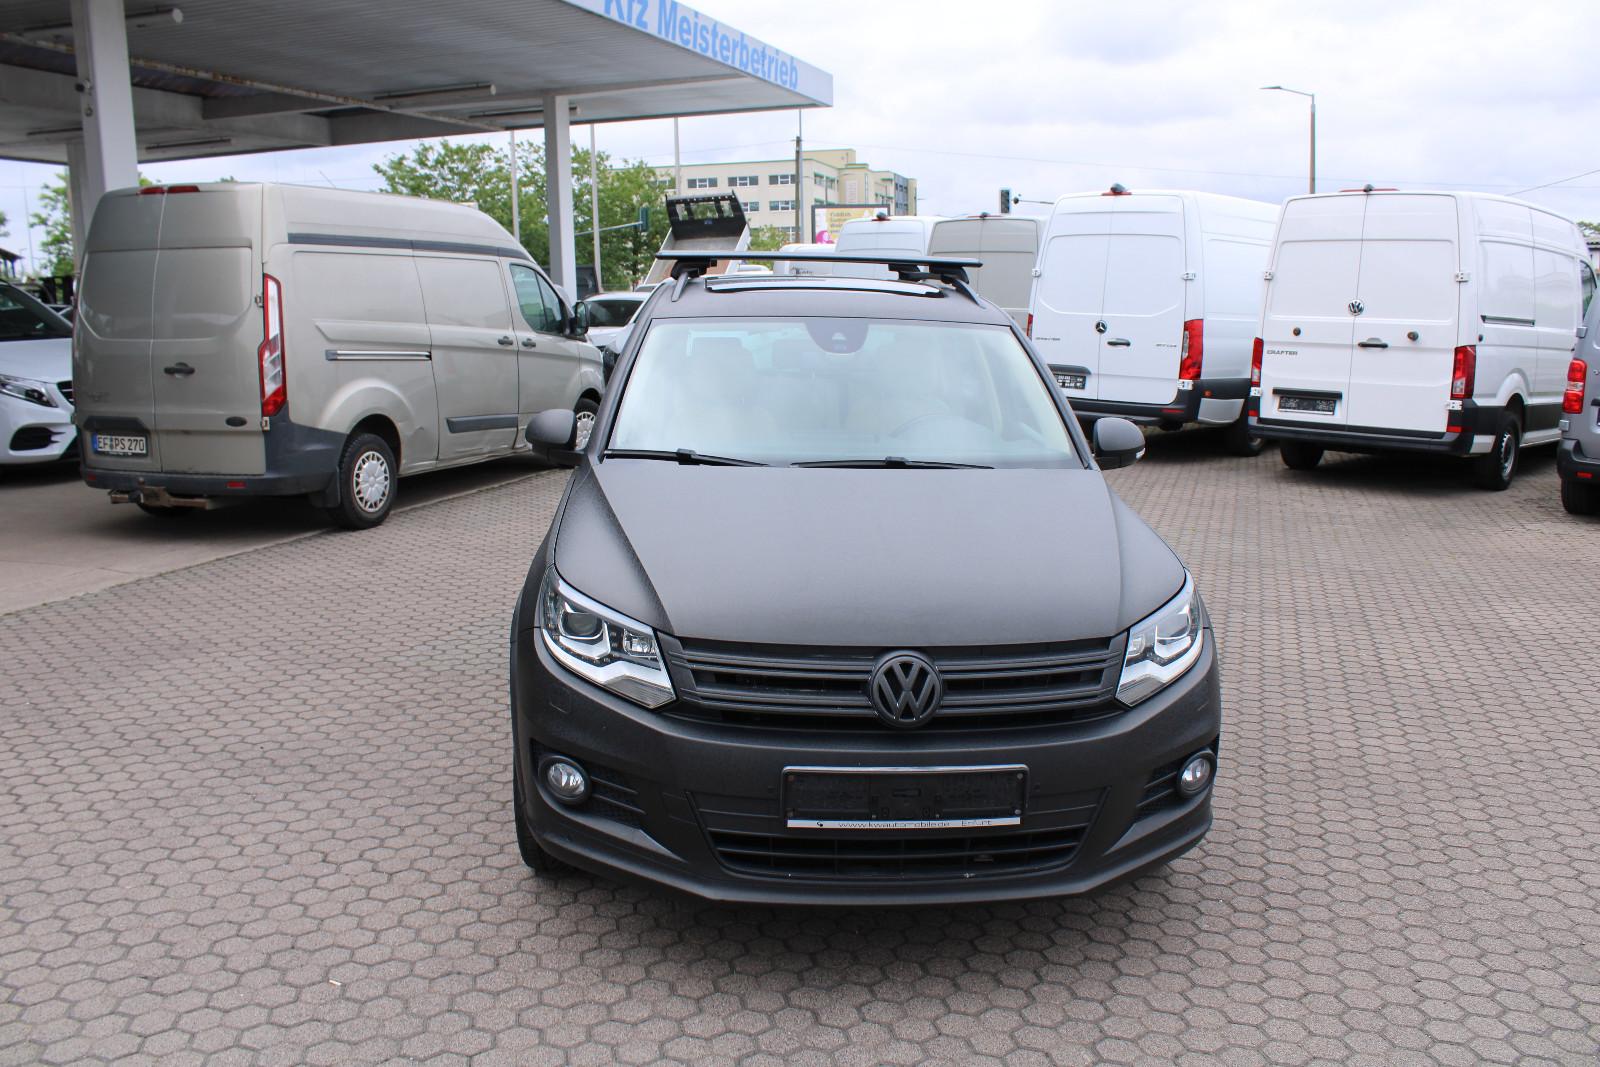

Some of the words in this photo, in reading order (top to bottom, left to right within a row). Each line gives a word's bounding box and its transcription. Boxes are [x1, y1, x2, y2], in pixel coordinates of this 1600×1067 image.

[657, 0, 799, 90] Meisterbetrieb
[97, 436, 109, 450] EF
[114, 437, 126, 450] PS
[127, 438, 145, 452] 270
[870, 651, 943, 727] VW
